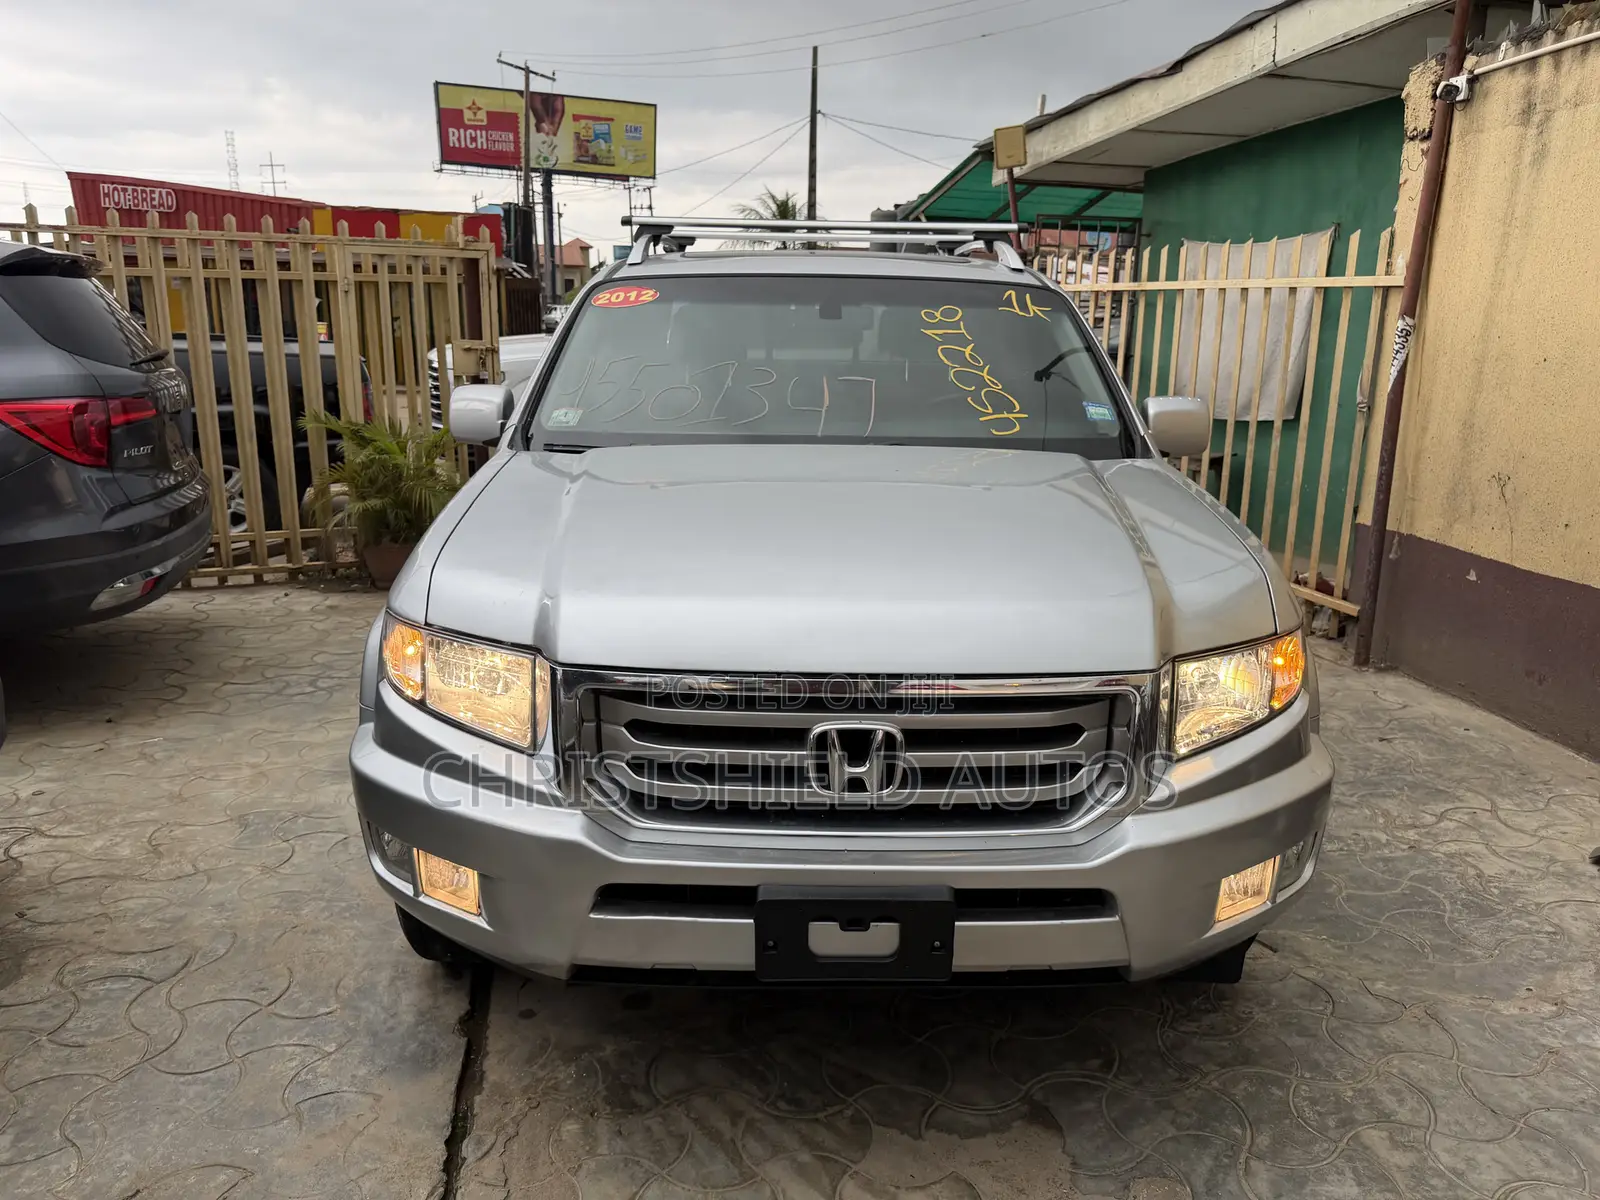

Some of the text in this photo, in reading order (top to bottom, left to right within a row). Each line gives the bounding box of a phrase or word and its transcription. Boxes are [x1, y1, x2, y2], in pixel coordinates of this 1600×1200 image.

[448, 127, 514, 150] RICH CHICKEN
[488, 140, 515, 152] FLAVOUR
[595, 289, 656, 305] 2012
[124, 445, 153, 458] PILOT
